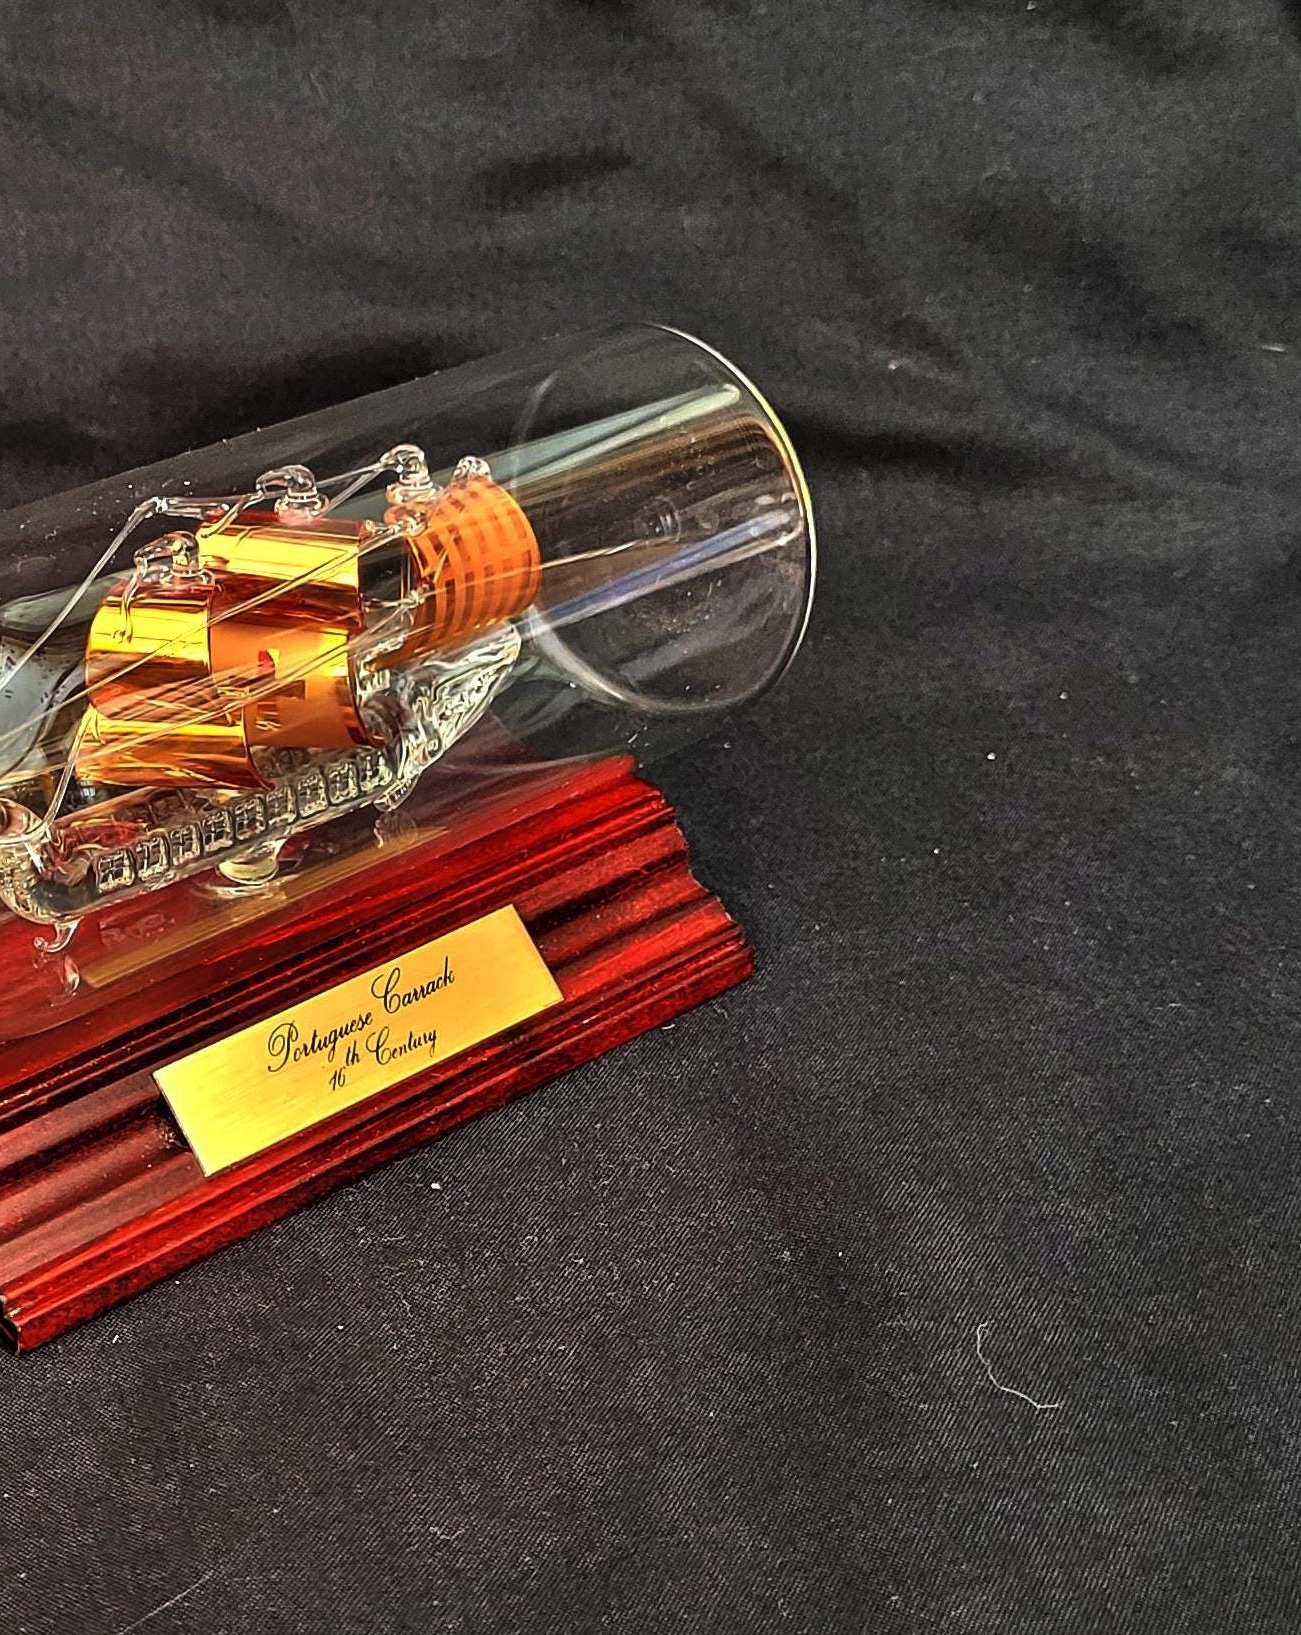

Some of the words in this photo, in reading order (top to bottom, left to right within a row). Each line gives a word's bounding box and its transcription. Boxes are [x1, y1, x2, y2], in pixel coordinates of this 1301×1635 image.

[267, 1009, 373, 1073] Portuguese
[371, 956, 455, 1014] Carrack
[366, 1026, 438, 1066] Century
